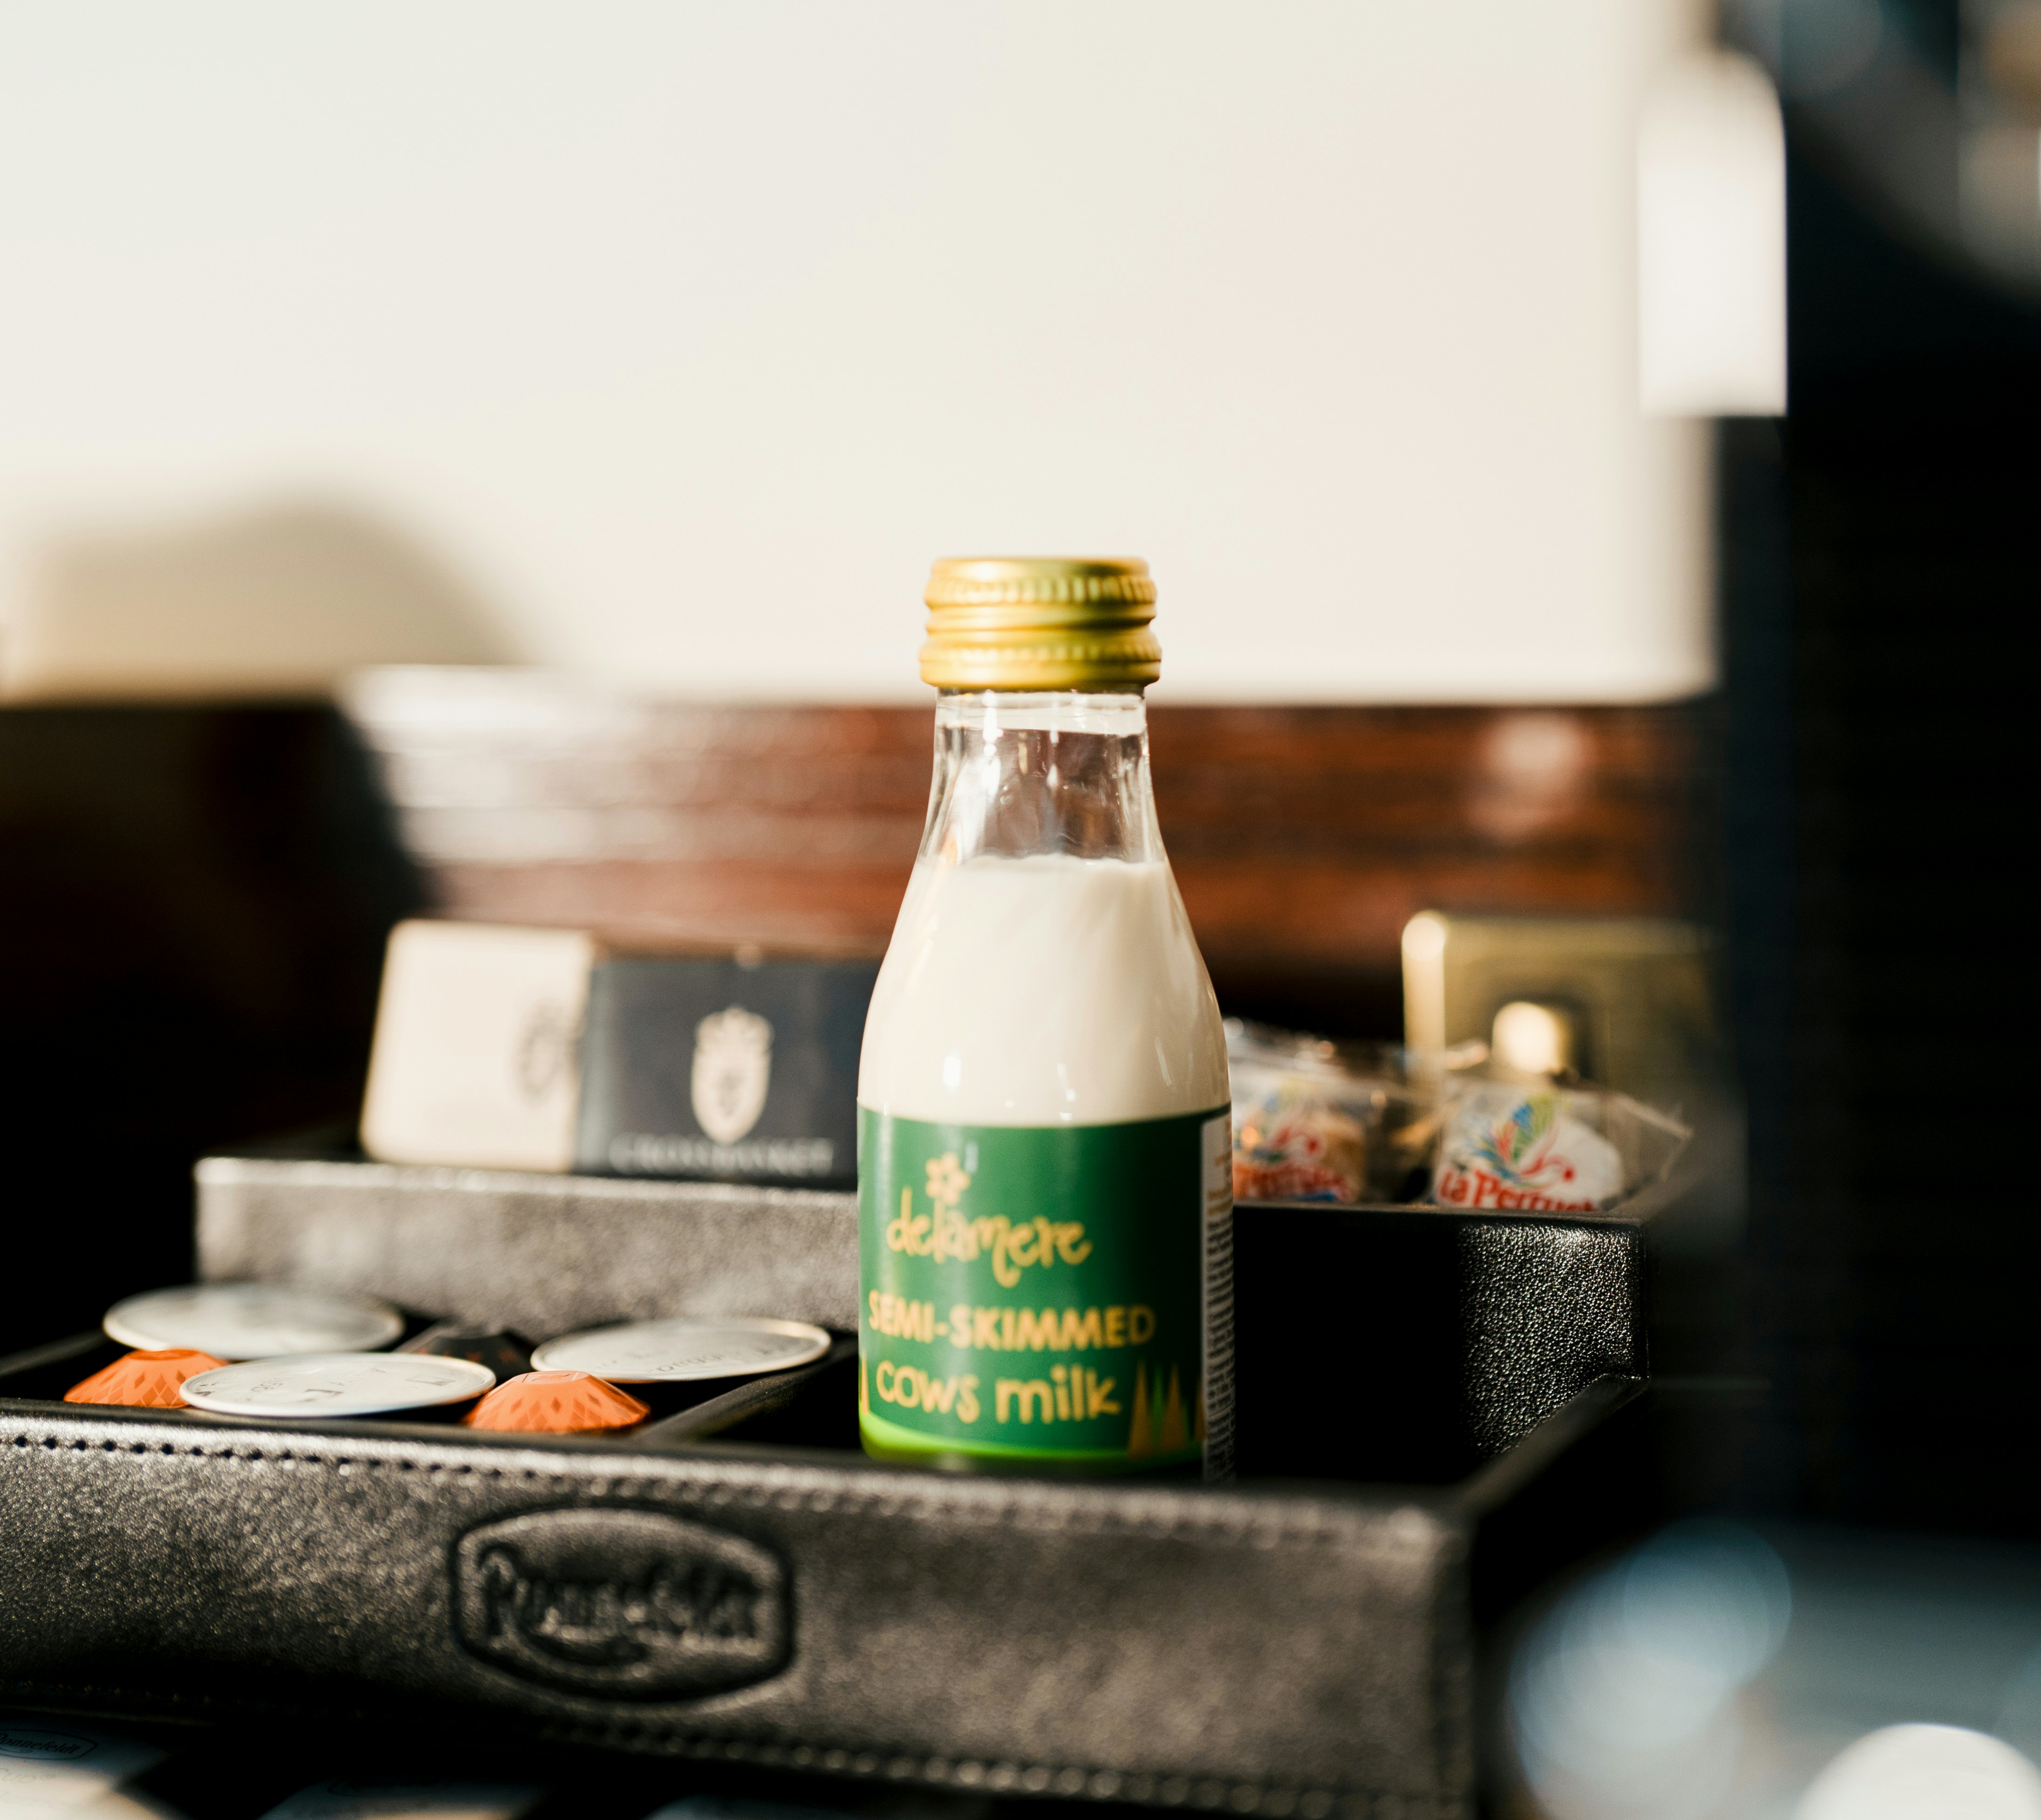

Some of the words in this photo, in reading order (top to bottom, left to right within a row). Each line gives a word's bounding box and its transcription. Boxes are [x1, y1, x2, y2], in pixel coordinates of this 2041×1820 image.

[886, 1186, 1093, 1288] delamere
[868, 1290, 1157, 1352] SEMI-SKIMMED
[996, 1364, 1121, 1424] milk
